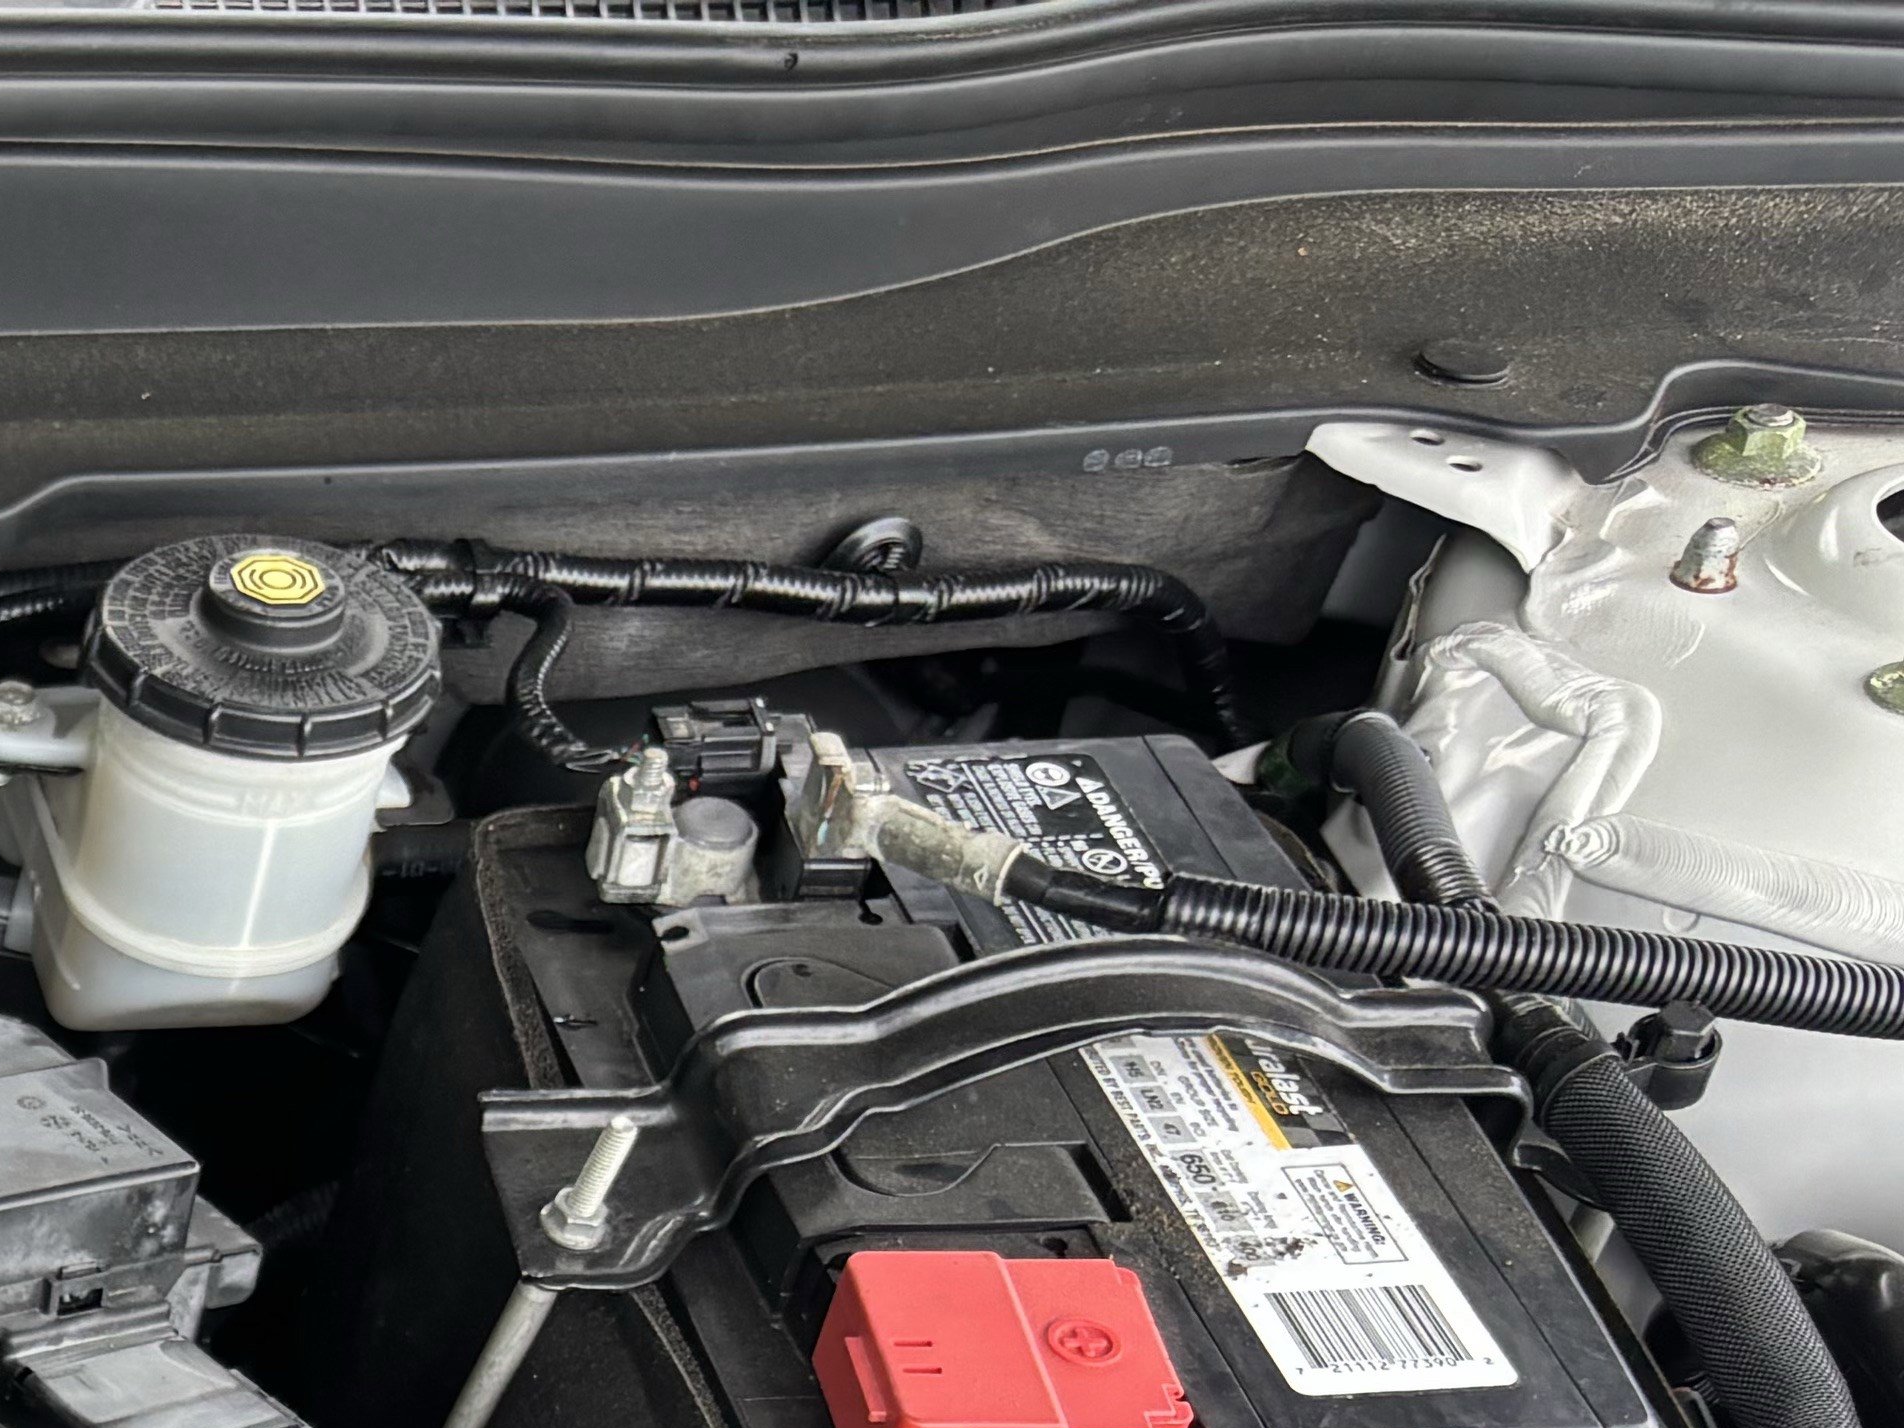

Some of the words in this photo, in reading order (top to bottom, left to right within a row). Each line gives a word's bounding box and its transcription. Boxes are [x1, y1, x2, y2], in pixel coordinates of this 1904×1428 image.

[1251, 1071, 1289, 1116] GOLD
[1179, 1153, 1218, 1185] 650
[1343, 1192, 1387, 1246] WARNING:
[1332, 1359, 1390, 1374] 21112
[1398, 1357, 1458, 1371] 77390
